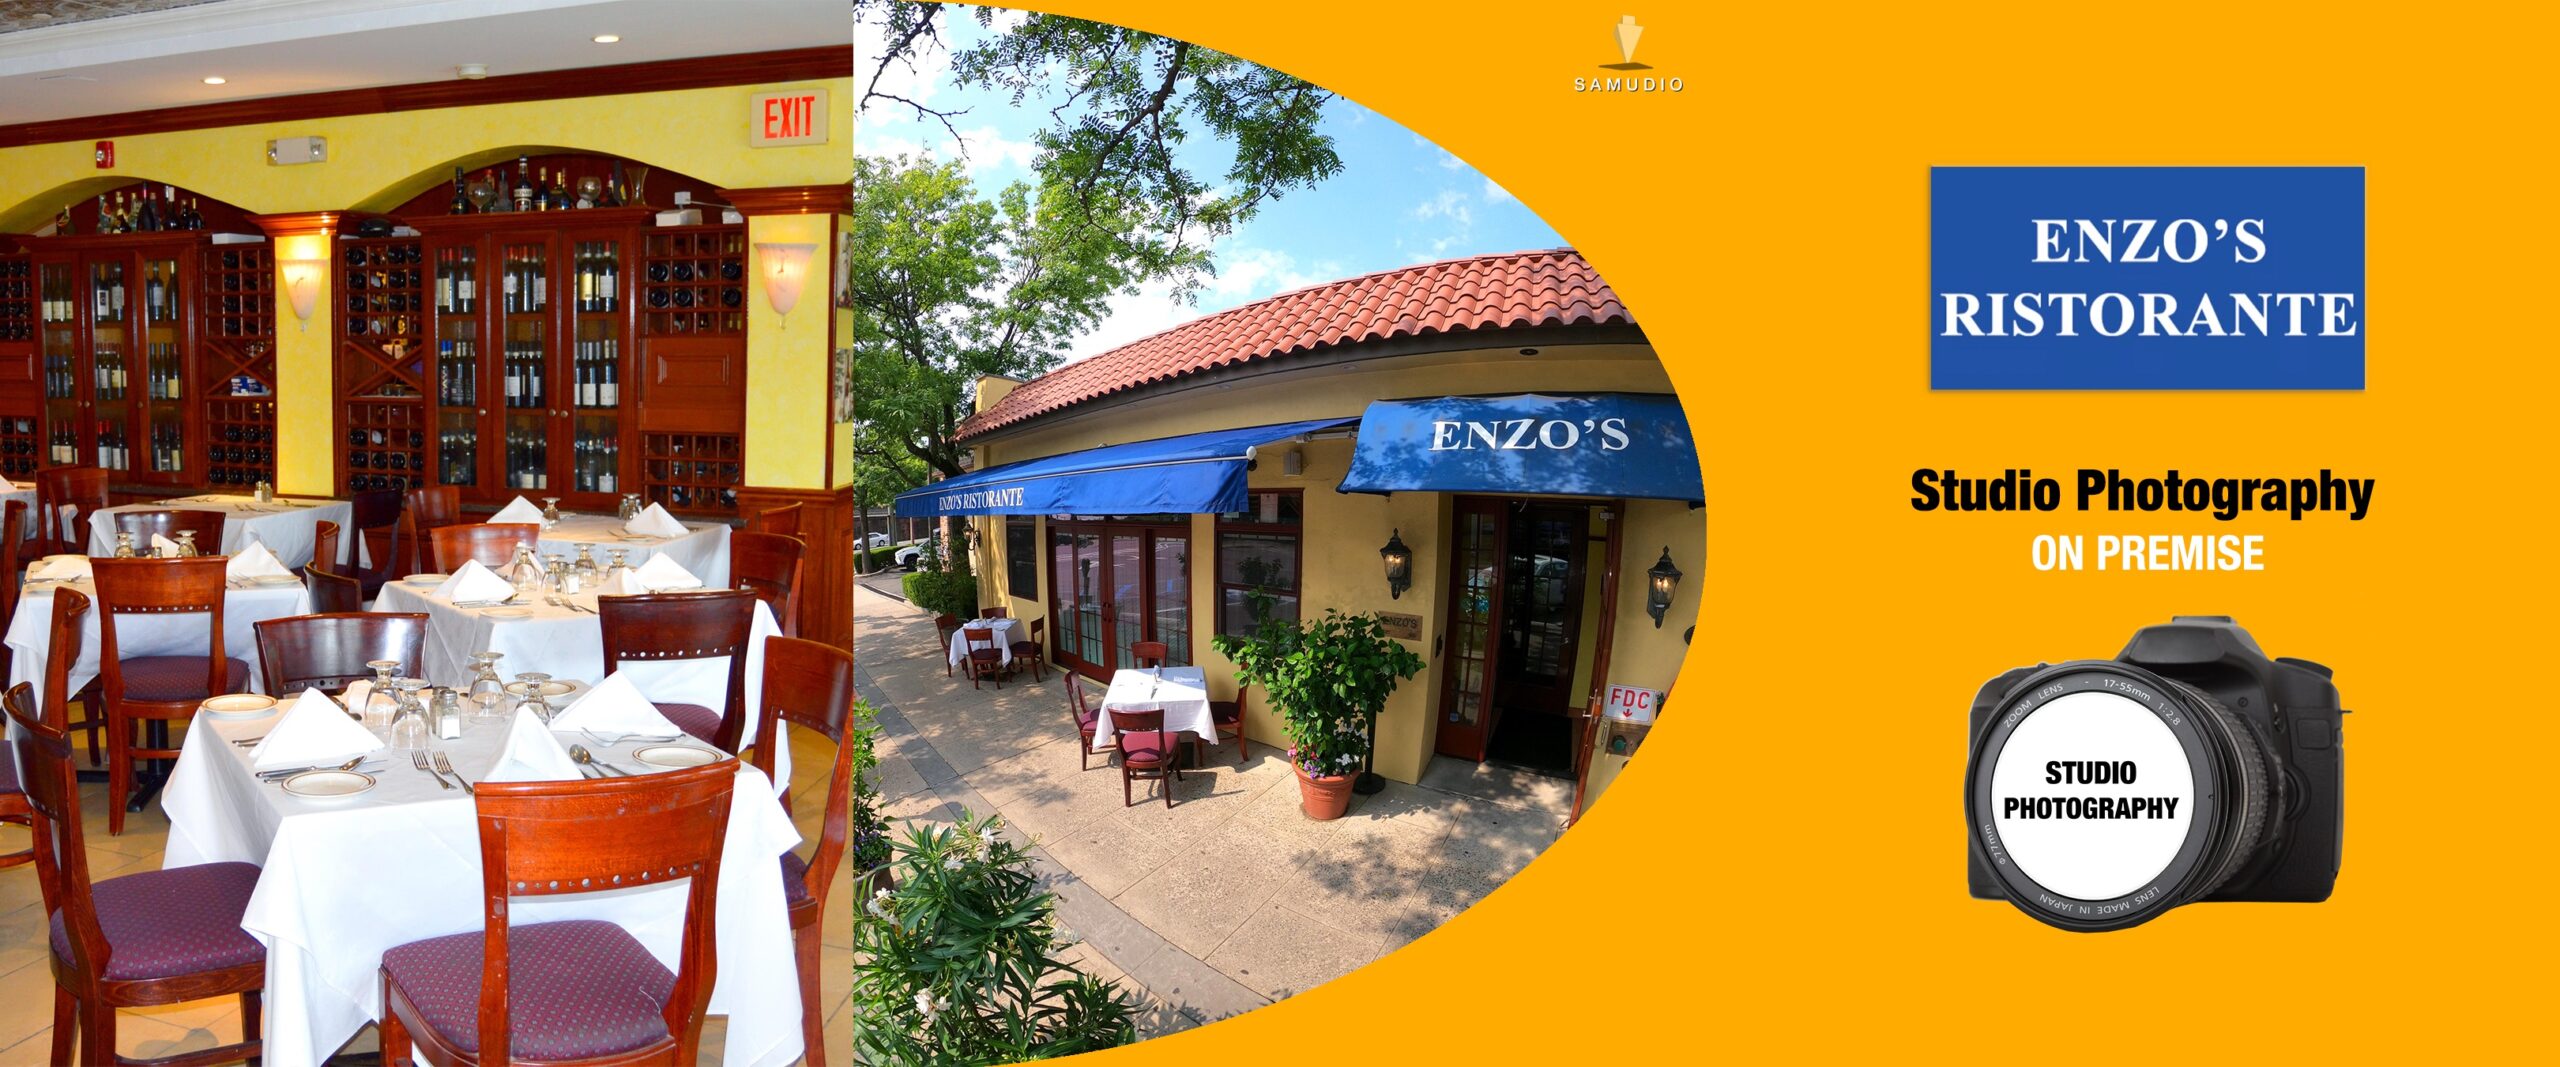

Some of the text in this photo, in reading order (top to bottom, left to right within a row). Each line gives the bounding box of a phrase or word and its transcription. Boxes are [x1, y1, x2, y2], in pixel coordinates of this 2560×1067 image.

[764, 96, 815, 139] EXIT
[1428, 418, 1630, 451] ENZO'S
[939, 487, 1024, 511] ENZO'S RISTORANTE
[1610, 687, 1651, 710] FDC
[2003, 699, 2033, 728] ZOOM
[2038, 682, 2065, 700] LENS
[2103, 678, 2152, 702] 17-55mm
[2156, 702, 2182, 727] 1:2.8
[2038, 885, 2161, 915] LENS MADE IN JAPAN
